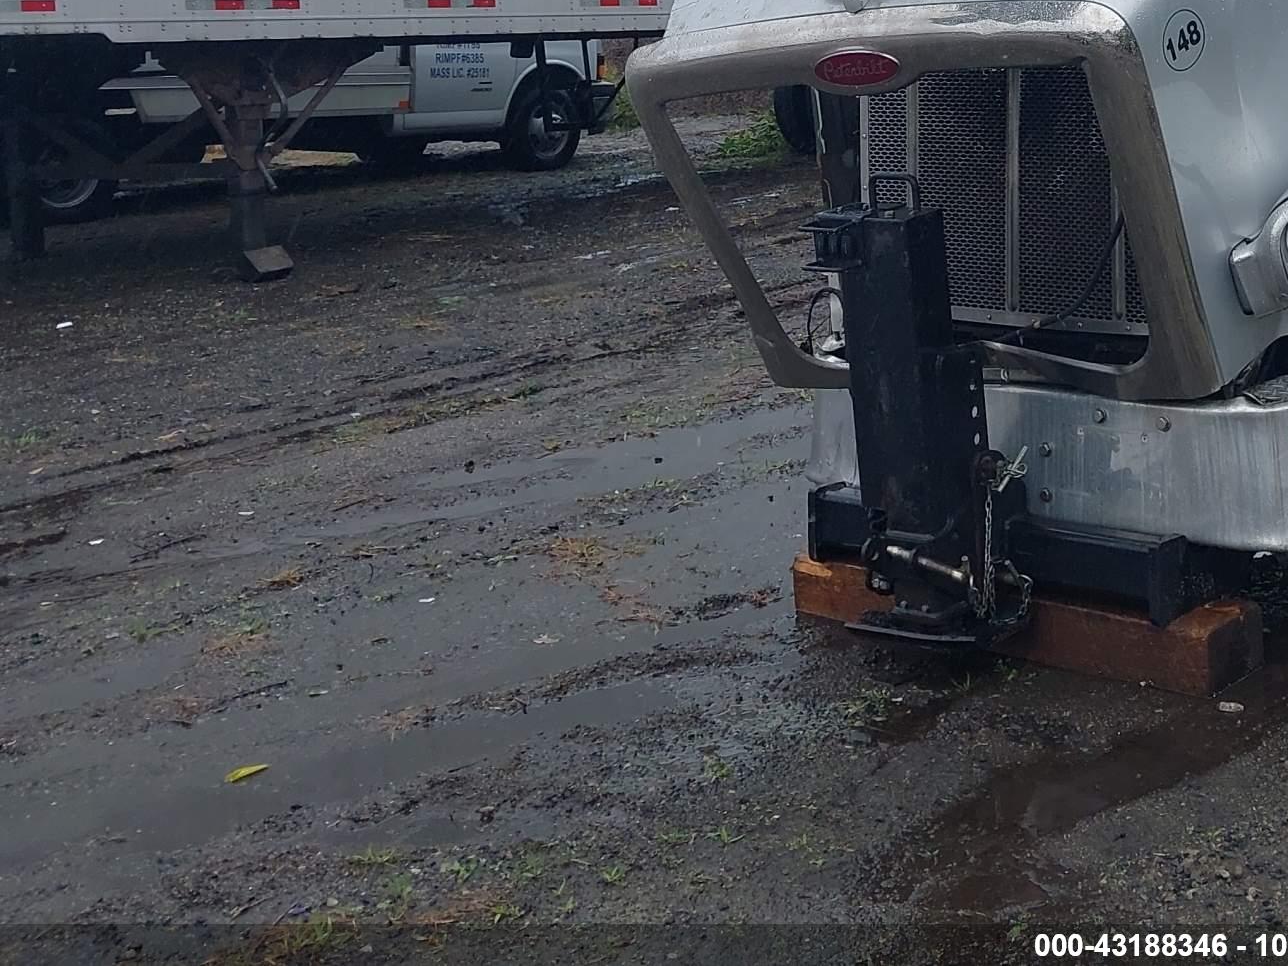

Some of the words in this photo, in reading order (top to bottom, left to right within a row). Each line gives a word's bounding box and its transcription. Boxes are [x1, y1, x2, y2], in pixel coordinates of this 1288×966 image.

[1167, 20, 1201, 61] 148
[430, 67, 451, 79] MASS
[823, 57, 890, 80] Peterbilt
